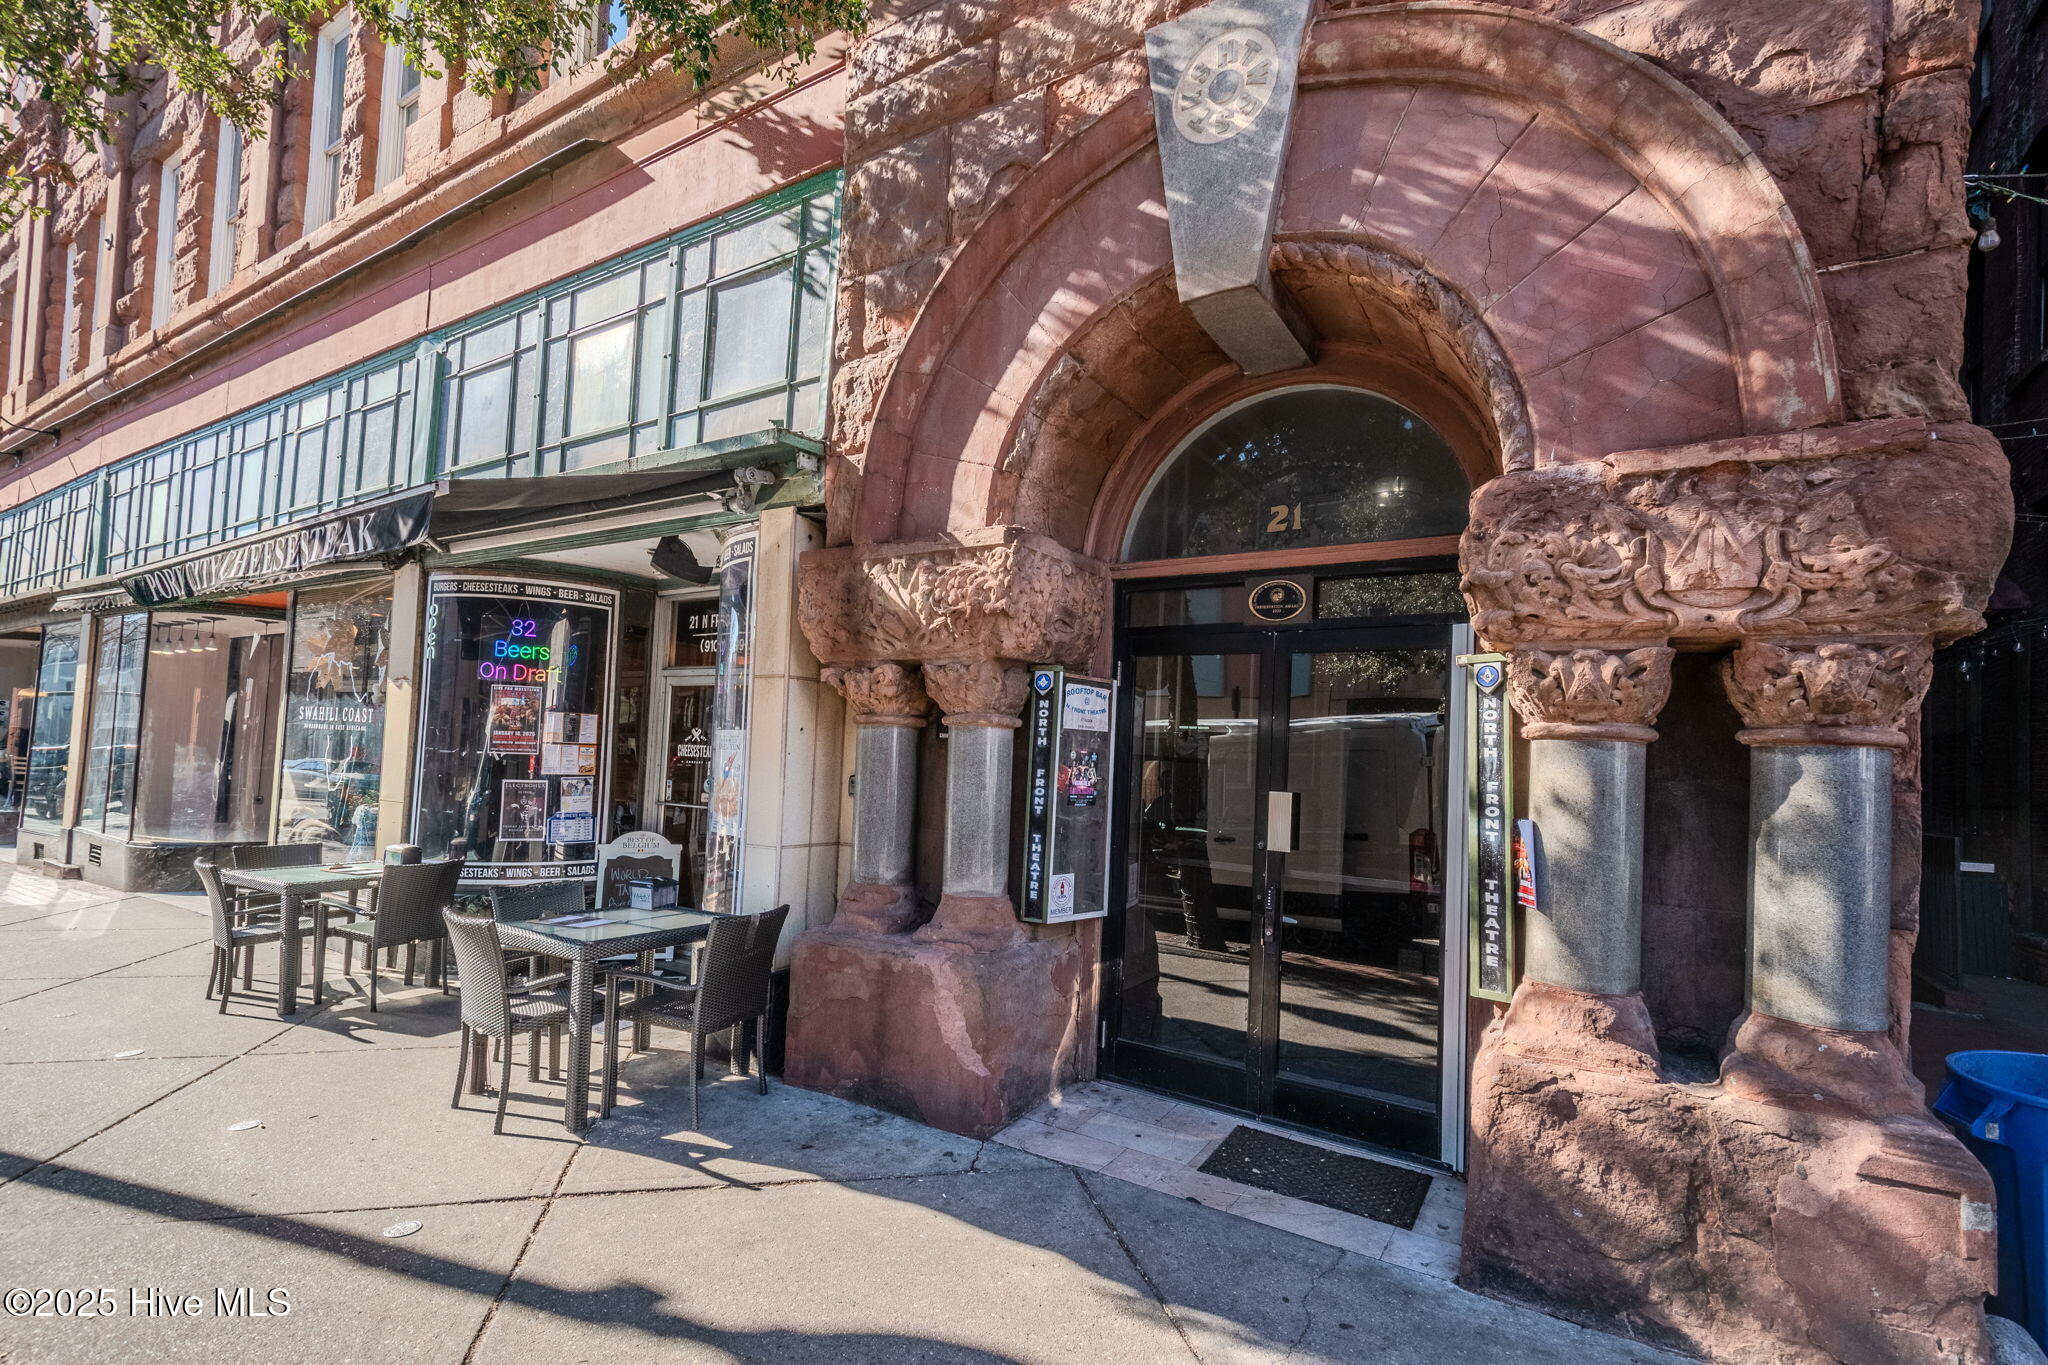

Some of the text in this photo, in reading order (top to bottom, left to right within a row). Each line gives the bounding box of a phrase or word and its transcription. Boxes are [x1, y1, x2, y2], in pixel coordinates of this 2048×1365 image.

[1267, 502, 1302, 532] 21
[145, 563, 187, 602] PORT
[220, 512, 377, 581] CHEESESTEAK
[733, 541, 754, 557] SALADS
[433, 582, 613, 605] BURGERS CHEESESTEAKS WINGS BEER SALADS
[511, 619, 537, 638] 32
[689, 615, 699, 629] 21
[702, 614, 708, 628] N
[494, 640, 551, 660] Beers
[480, 662, 562, 683] On Draft
[1066, 687, 1107, 701] ROOFTOP BAR
[299, 706, 374, 723] SWAHILI COAST
[1071, 706, 1086, 715] FRONT
[1087, 707, 1107, 715] THEATRE
[677, 744, 712, 758] CHEESESTEA
[1030, 700, 1049, 900] NORTH FRONT THEATRE
[1483, 697, 1500, 967] NORTH FRONT THEATRE
[459, 865, 596, 878] SESTEAKS WINGS BEER SALADS
[610, 867, 650, 881] WORLD
[1050, 906, 1073, 915] MEMBER
